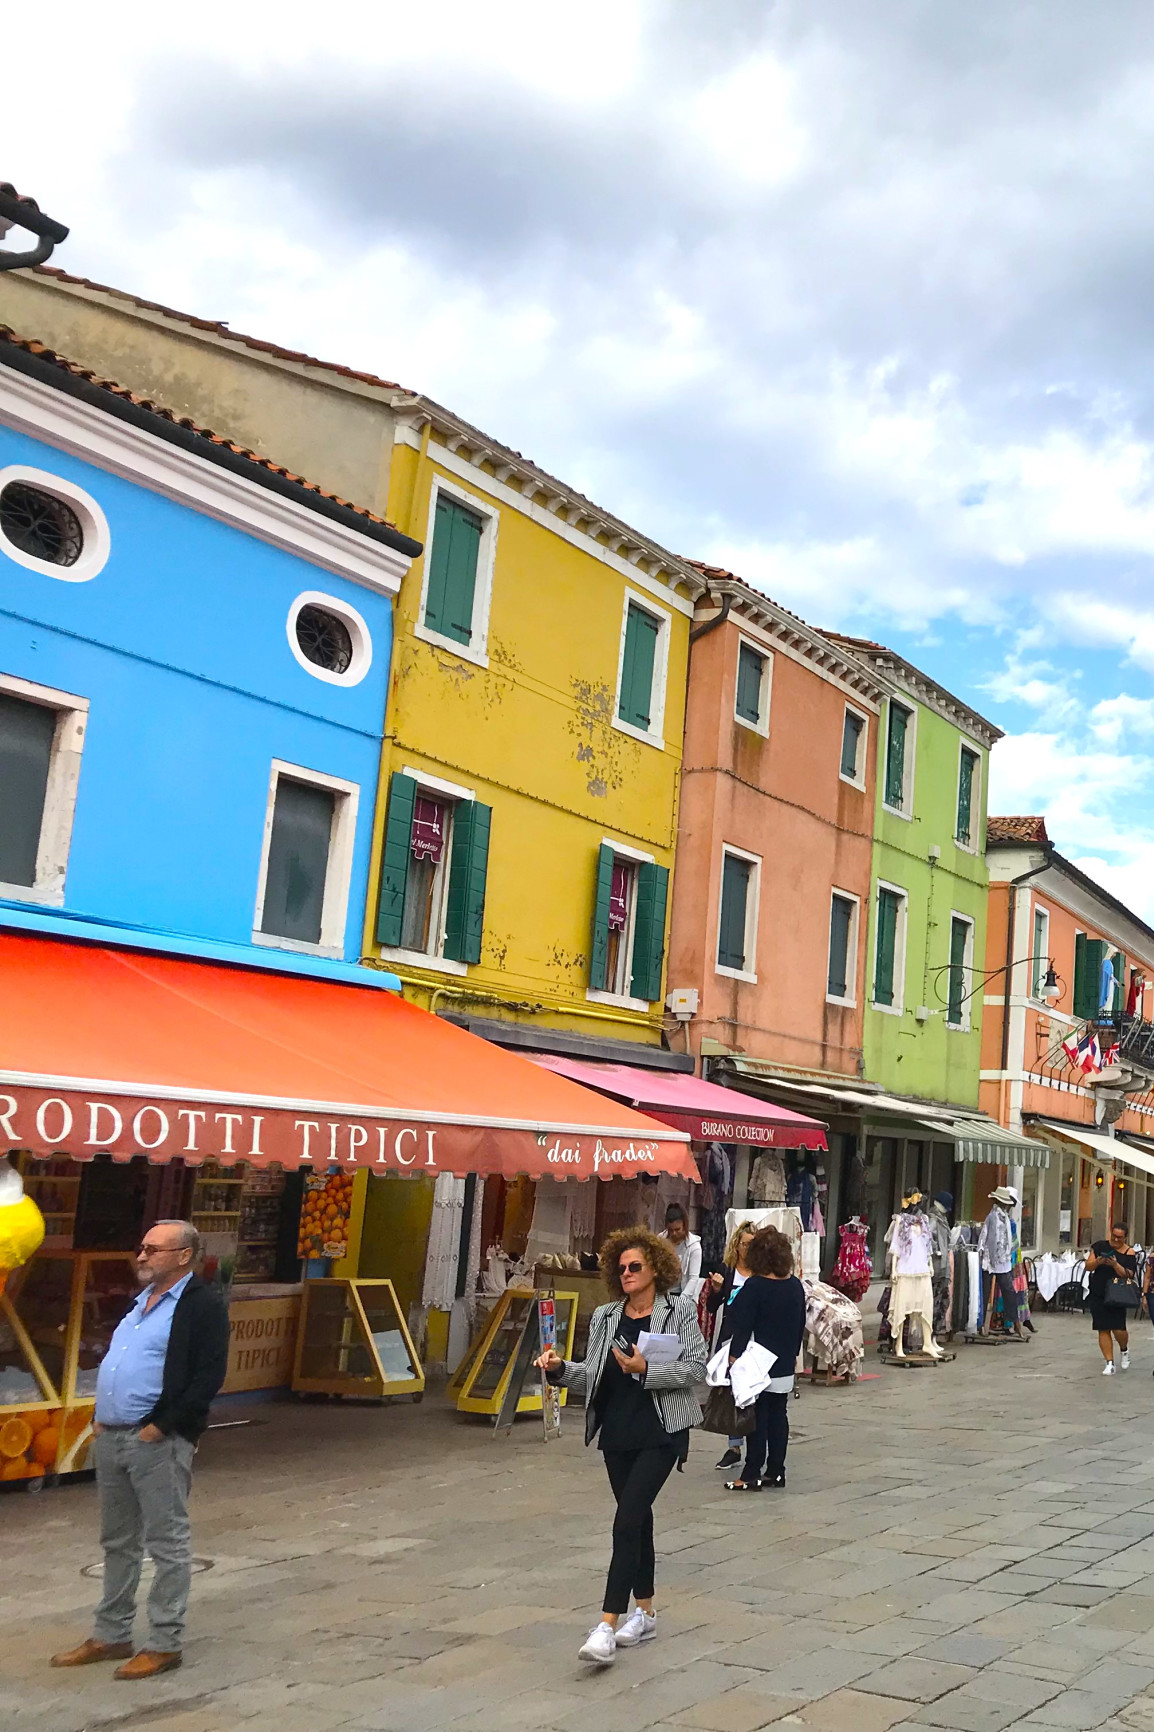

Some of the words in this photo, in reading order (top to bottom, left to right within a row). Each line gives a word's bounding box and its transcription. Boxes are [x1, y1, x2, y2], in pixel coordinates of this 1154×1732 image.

[294, 1120, 438, 1166] TIPICI
[701, 1121, 734, 1138] BURANO
[735, 1125, 775, 1142] COLLECTION
[236, 1347, 282, 1371] TIPICI
